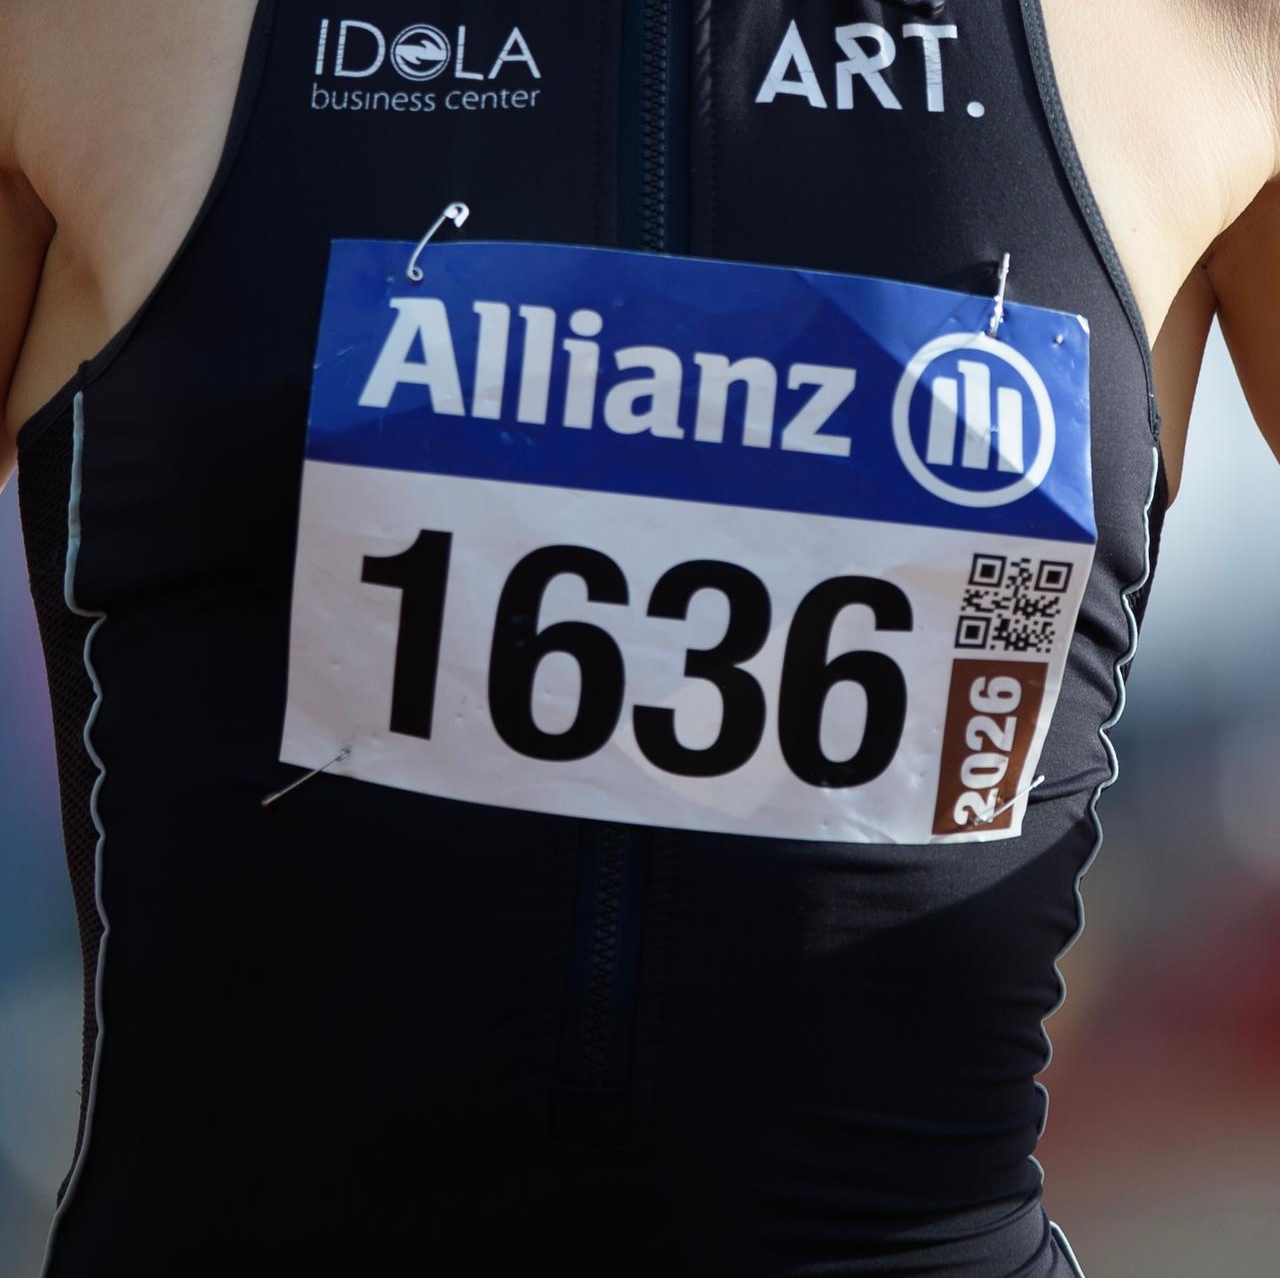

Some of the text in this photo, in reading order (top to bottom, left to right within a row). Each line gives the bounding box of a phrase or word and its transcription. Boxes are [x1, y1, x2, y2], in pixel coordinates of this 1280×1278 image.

[311, 83, 540, 111] business center
[315, 18, 542, 81] IDOLA
[755, 19, 984, 118] ART.
[359, 297, 856, 456] Allianz
[360, 529, 913, 789] 1636
[953, 676, 1022, 826] 2026
